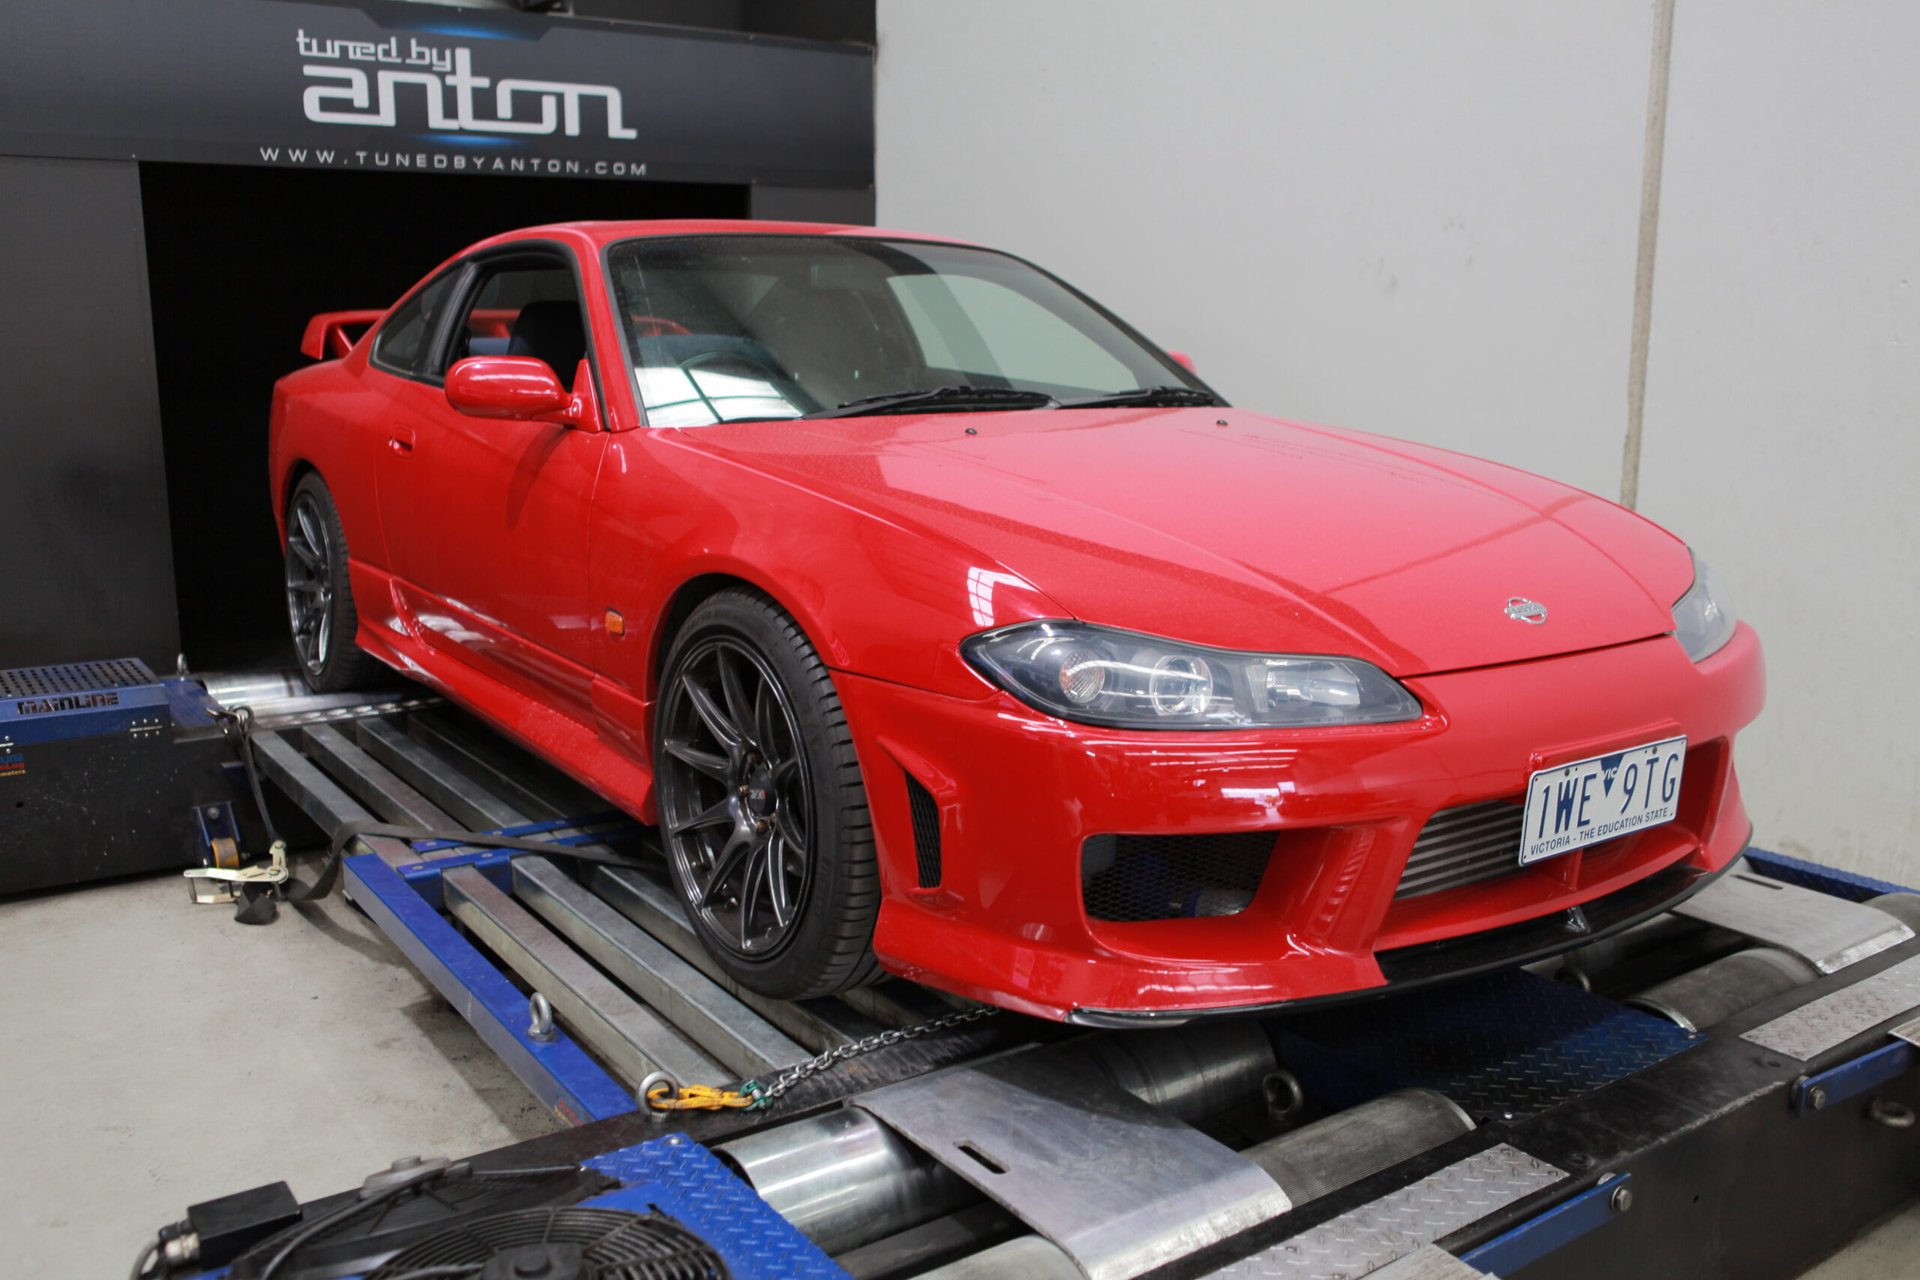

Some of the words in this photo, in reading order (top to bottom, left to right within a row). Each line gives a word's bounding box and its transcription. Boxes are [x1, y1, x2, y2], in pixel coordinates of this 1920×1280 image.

[296, 29, 401, 63] tuned
[406, 38, 452, 72] by
[302, 47, 638, 140] anton
[259, 146, 648, 177] WWW.TUNEDBYANTON.COM
[1538, 773, 1597, 838] 1WE
[1621, 752, 1679, 814] 9TG
[1530, 835, 1571, 855] VICTORIA
[1579, 827, 1595, 842] THE
[1597, 813, 1643, 837] EDUCATION
[1644, 806, 1668, 822] STATE
